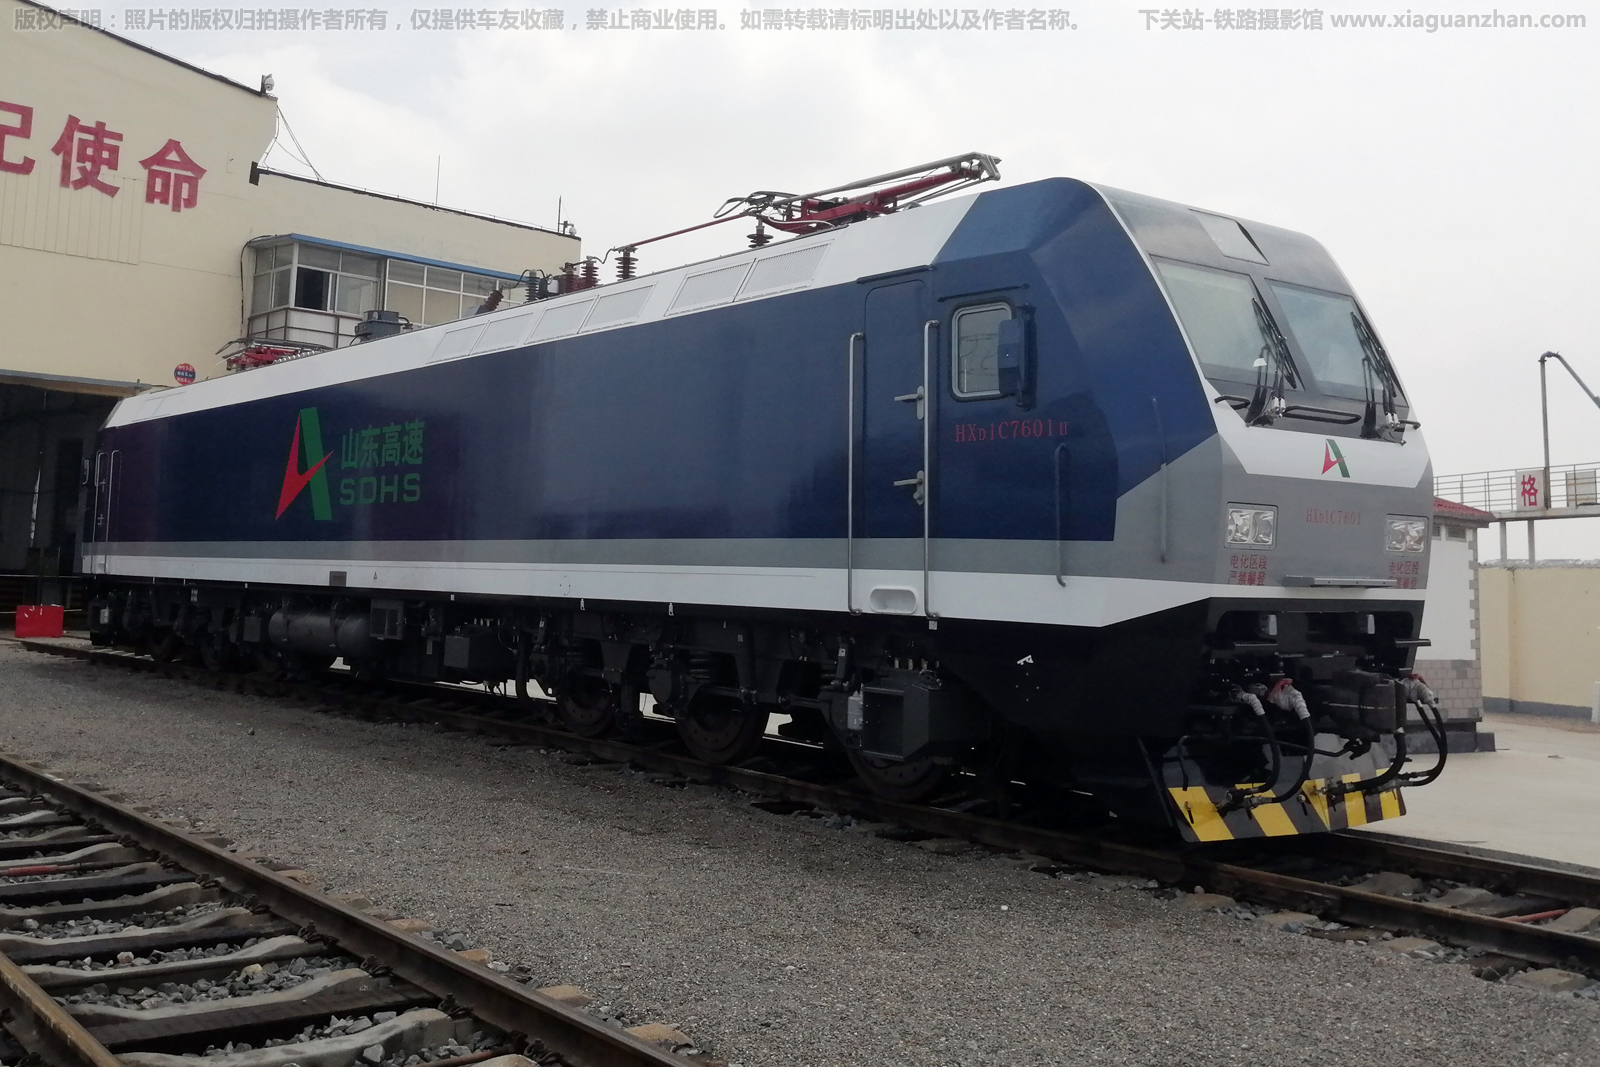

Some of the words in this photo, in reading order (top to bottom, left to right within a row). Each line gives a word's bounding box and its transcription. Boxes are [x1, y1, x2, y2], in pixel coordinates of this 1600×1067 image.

[341, 419, 425, 470] 山东高速
[339, 473, 421, 505] SDHS
[1520, 474, 1539, 507] 格
[1230, 553, 1268, 570] 电化区段
